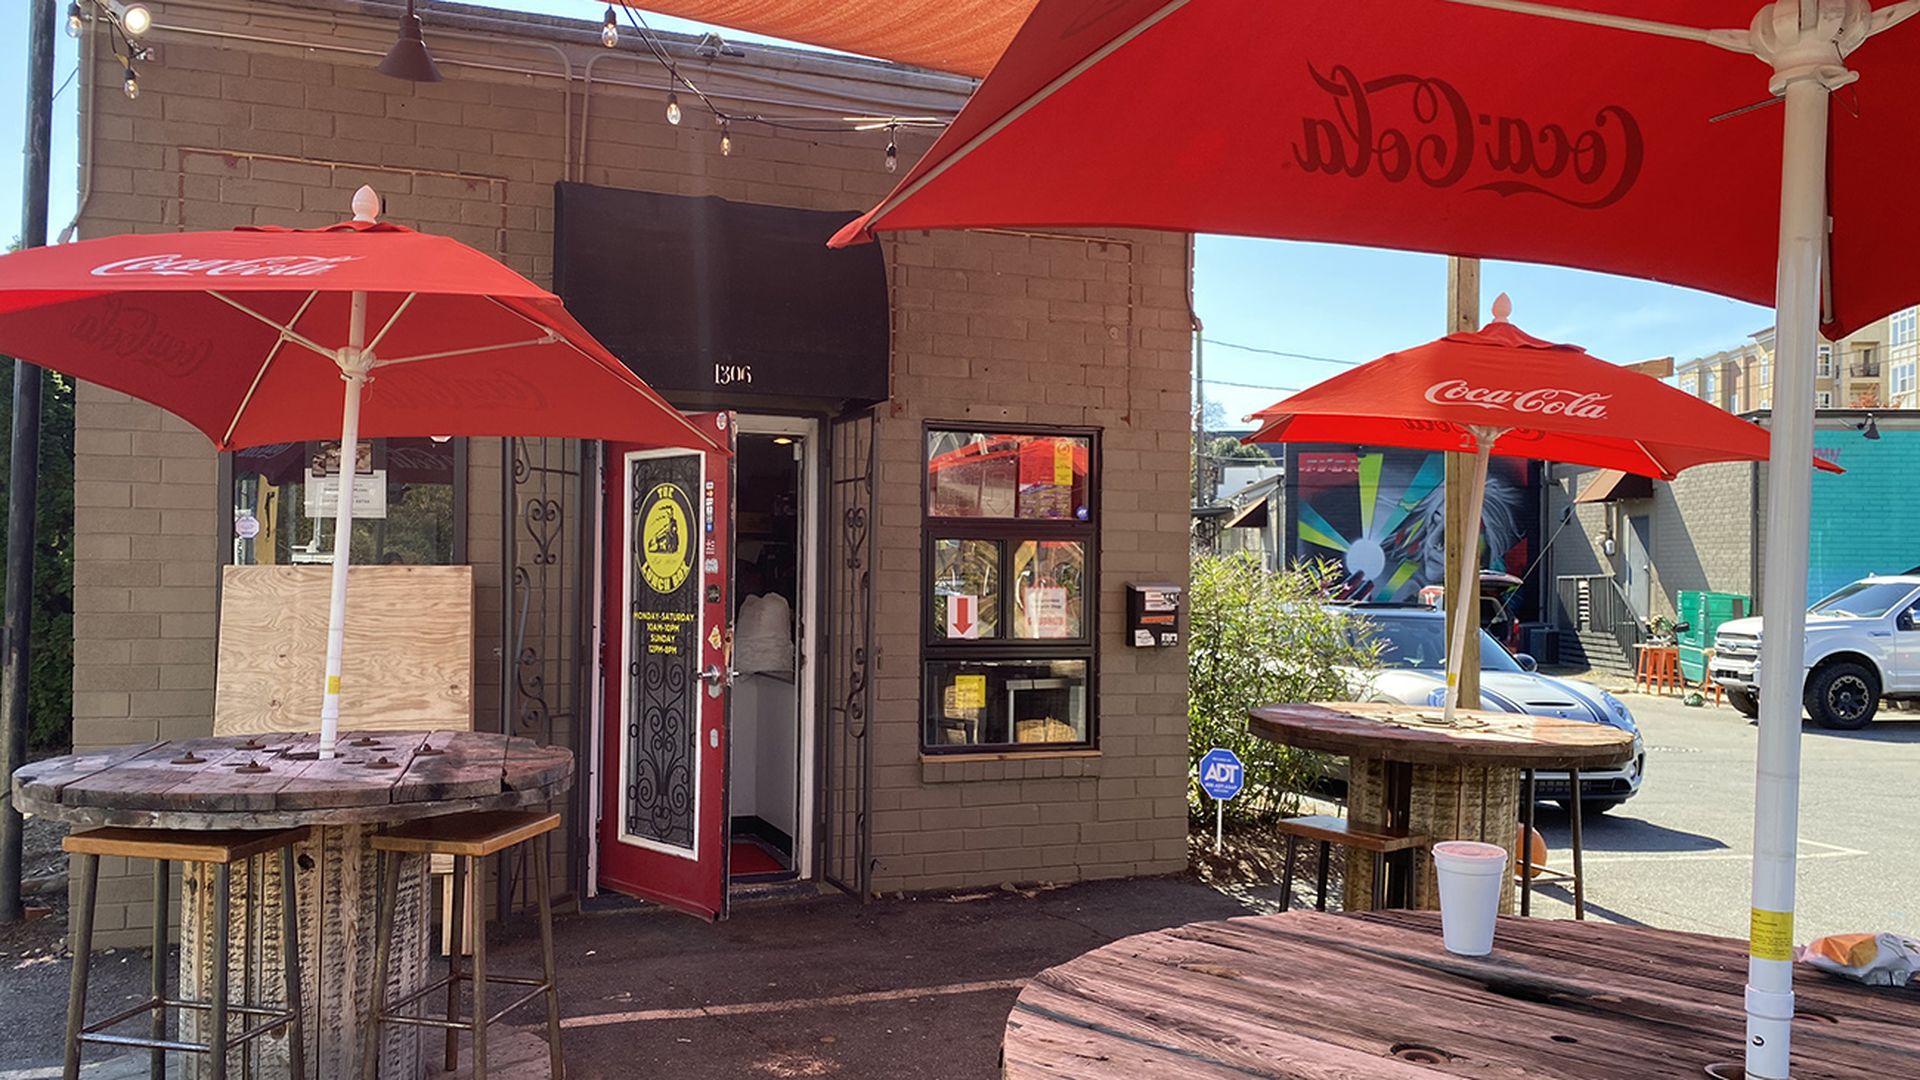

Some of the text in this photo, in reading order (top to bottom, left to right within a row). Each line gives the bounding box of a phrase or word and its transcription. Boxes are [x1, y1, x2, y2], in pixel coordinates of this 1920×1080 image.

[714, 363, 752, 385] 1306
[1424, 379, 1613, 420] Coca-Cola
[656, 485, 675, 499] THE
[641, 561, 671, 591] LUNCH
[672, 560, 690, 587] BOX
[633, 611, 695, 622] MONDAY-SATURDAY
[650, 633, 676, 643] SUNDAY
[1204, 762, 1240, 784] ADT
